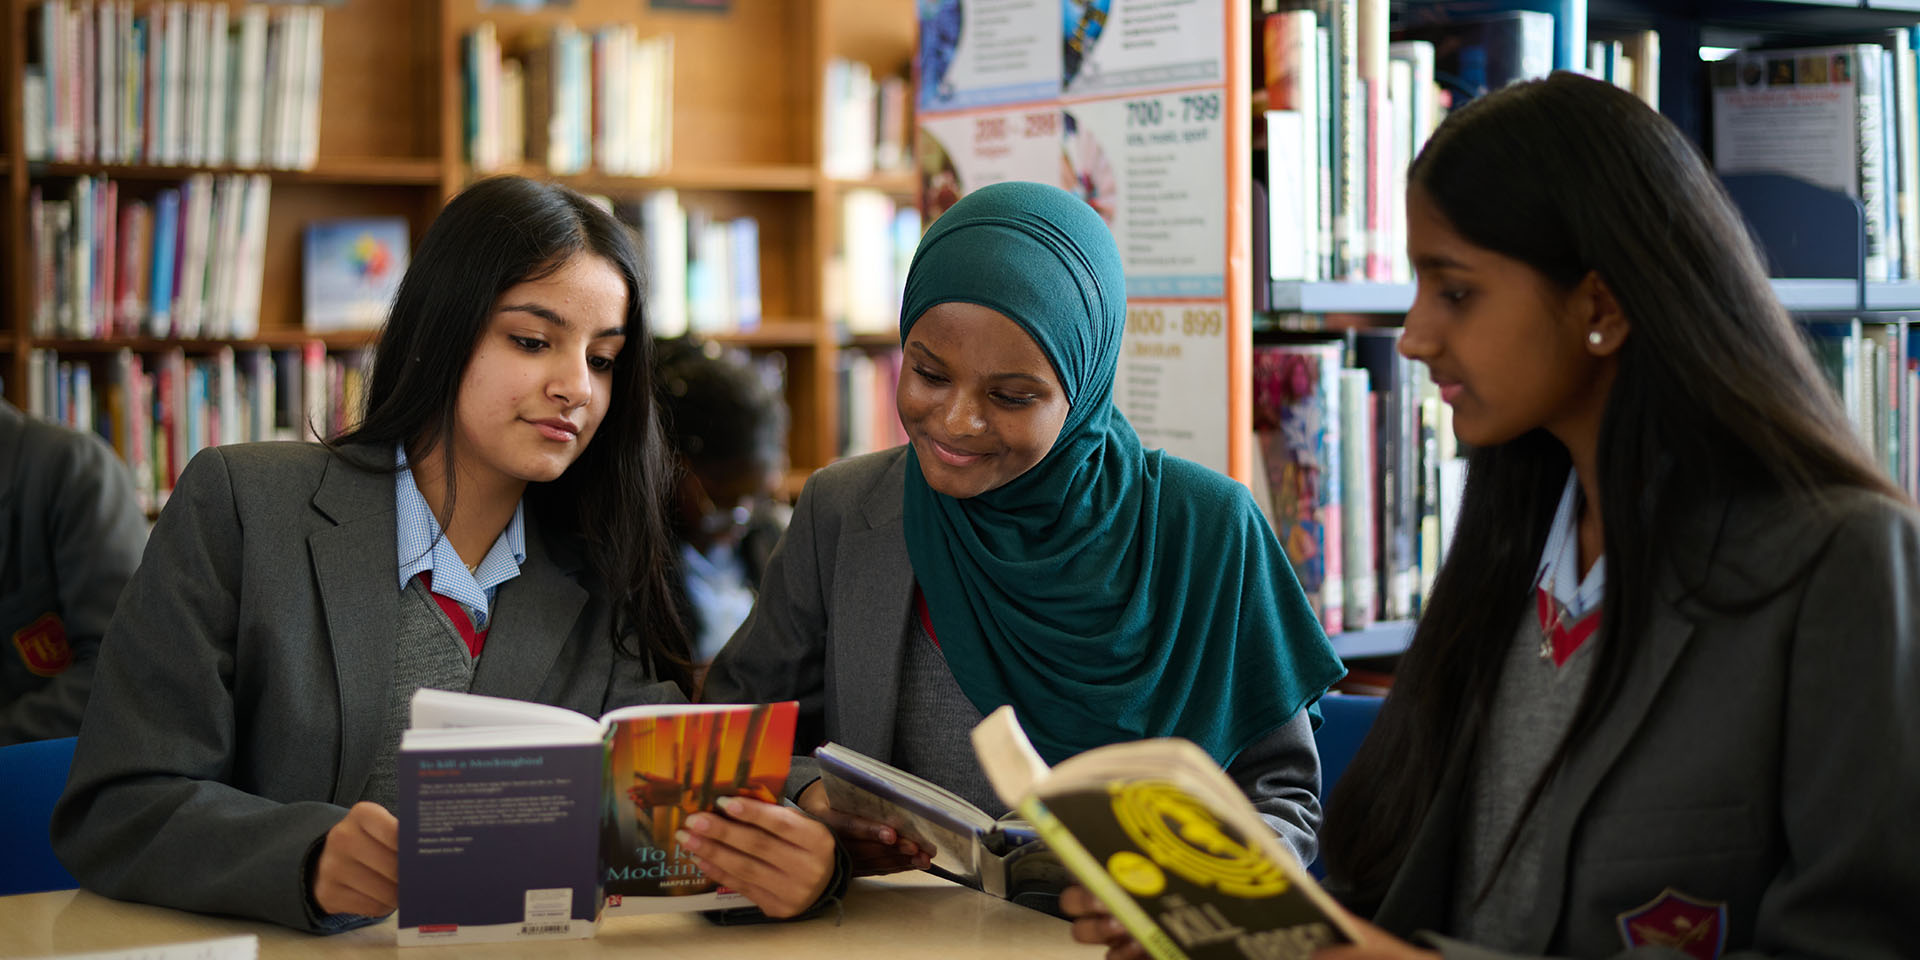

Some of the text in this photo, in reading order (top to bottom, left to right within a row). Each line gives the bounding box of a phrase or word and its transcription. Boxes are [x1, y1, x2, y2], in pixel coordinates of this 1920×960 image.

[1125, 100, 1162, 128] 700
[1181, 94, 1218, 122] 799
[1183, 310, 1221, 336] 899
[636, 847, 666, 862] To
